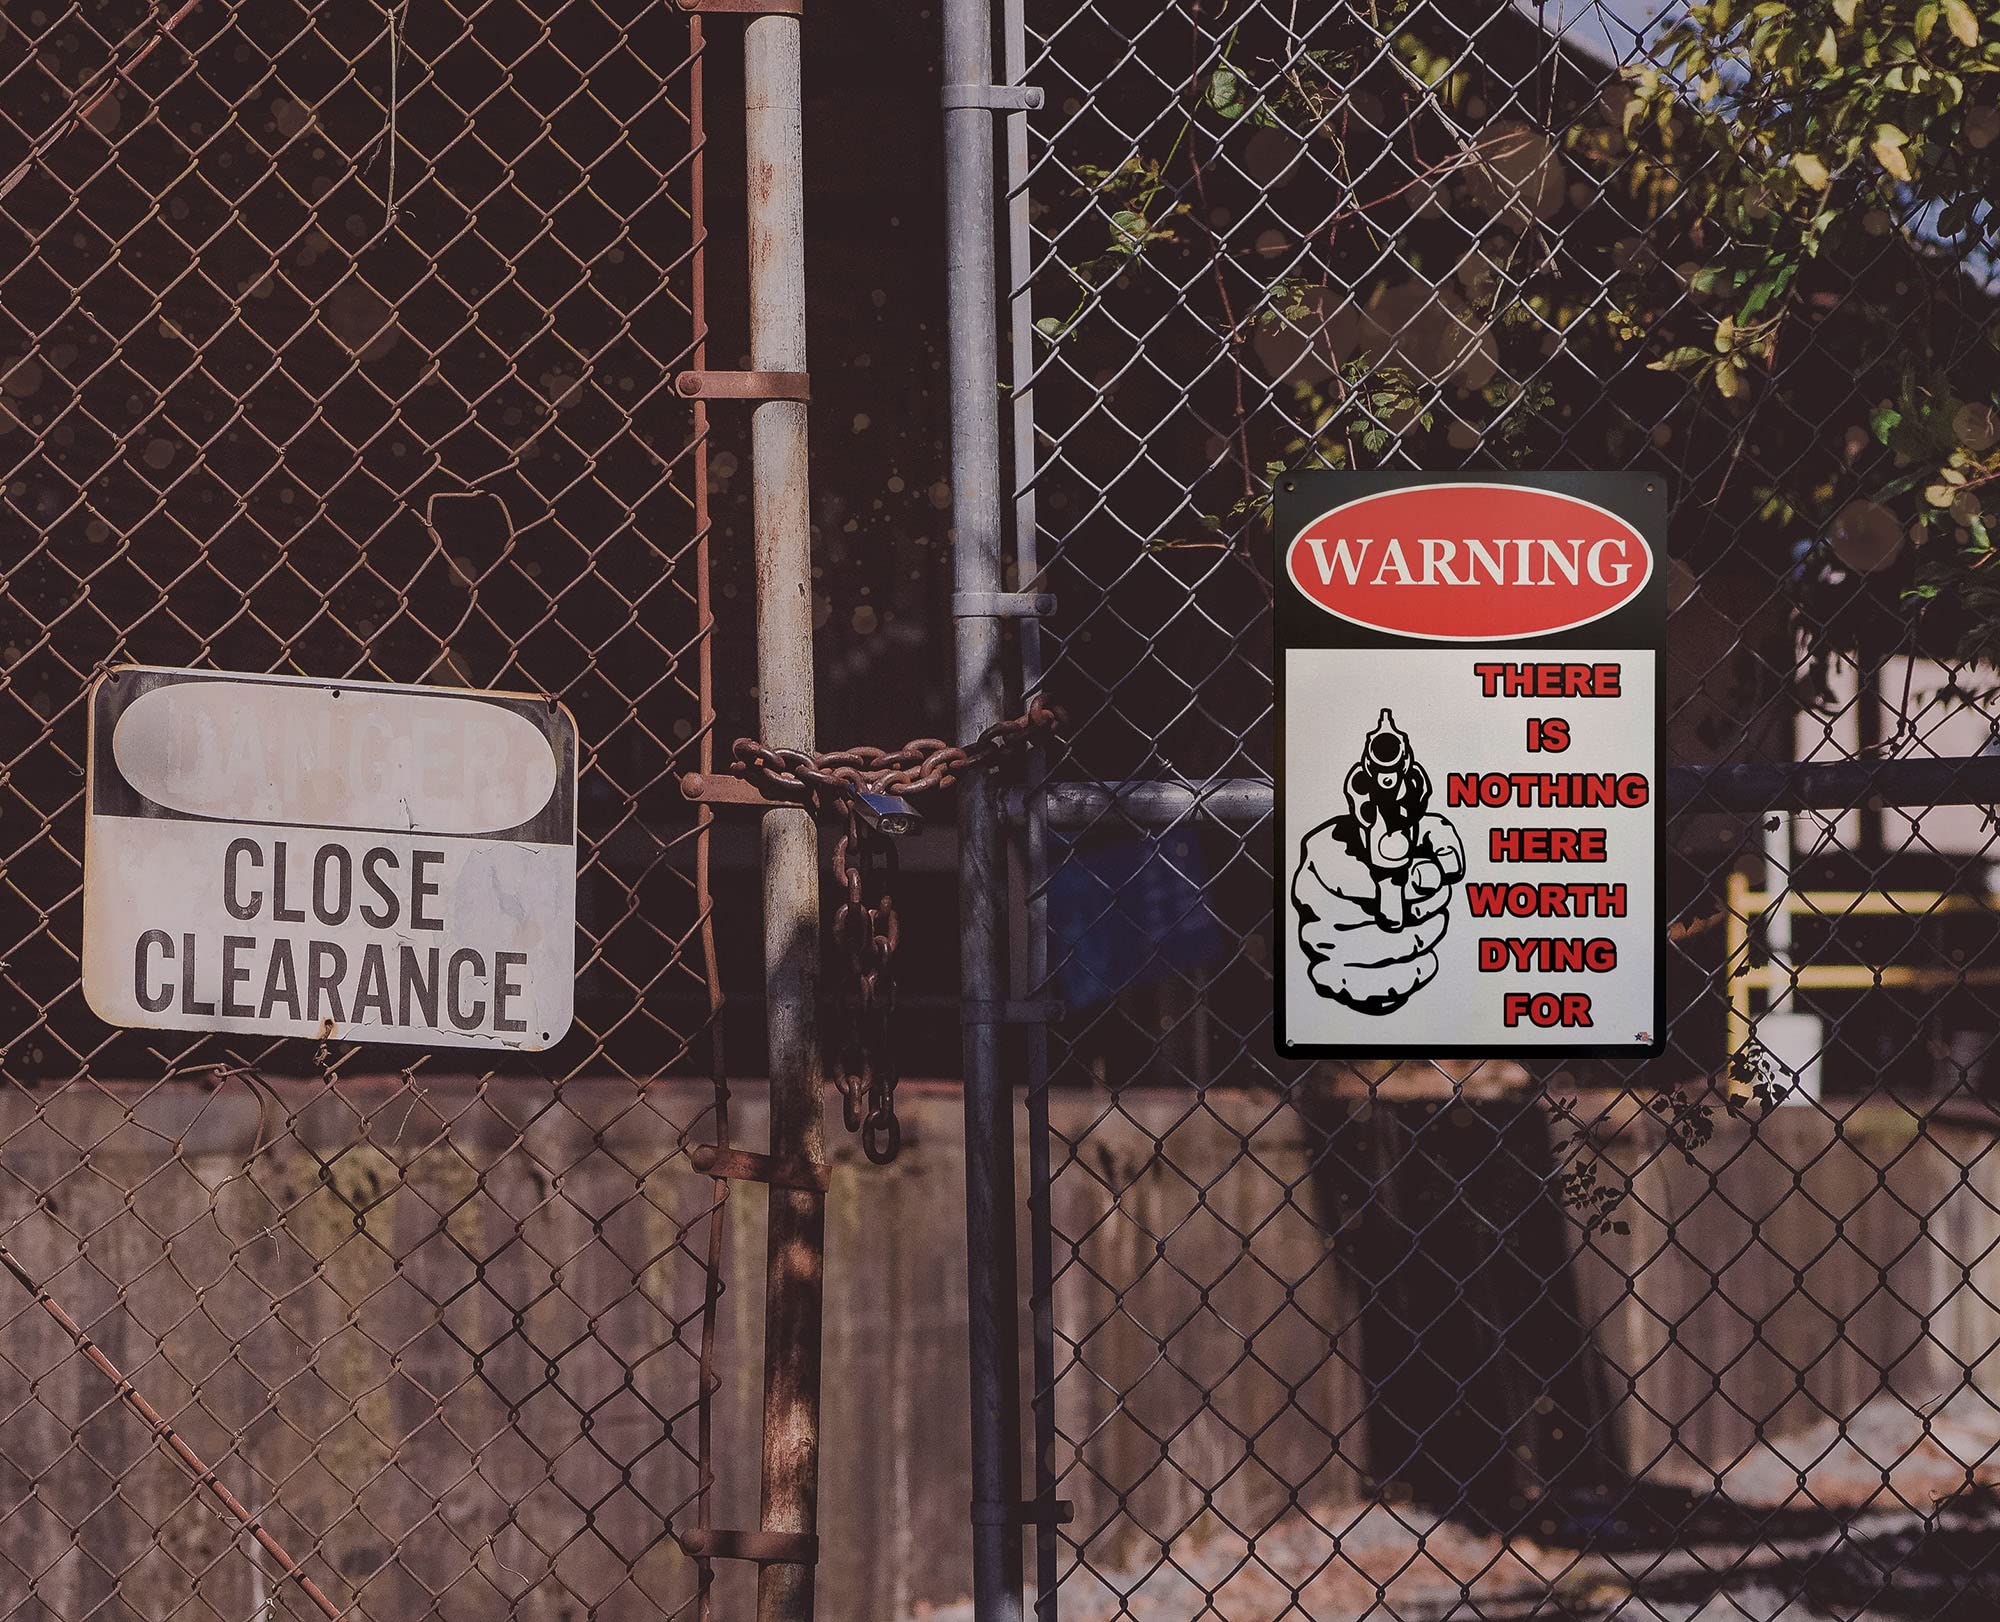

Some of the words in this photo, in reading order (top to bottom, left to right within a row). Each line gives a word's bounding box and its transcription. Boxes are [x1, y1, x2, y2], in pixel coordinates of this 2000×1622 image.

[1305, 539, 1633, 586] WARNING
[1474, 663, 1621, 698] THERE
[1526, 718, 1571, 752] IS
[1447, 773, 1650, 808] NOTHING
[1489, 829, 1607, 862] HERE
[224, 838, 445, 931] CLOSE
[1466, 883, 1628, 918] WORTH
[1478, 938, 1618, 973] DYING
[134, 929, 528, 1032] CLEARANCE
[1504, 993, 1593, 1028] FOR
